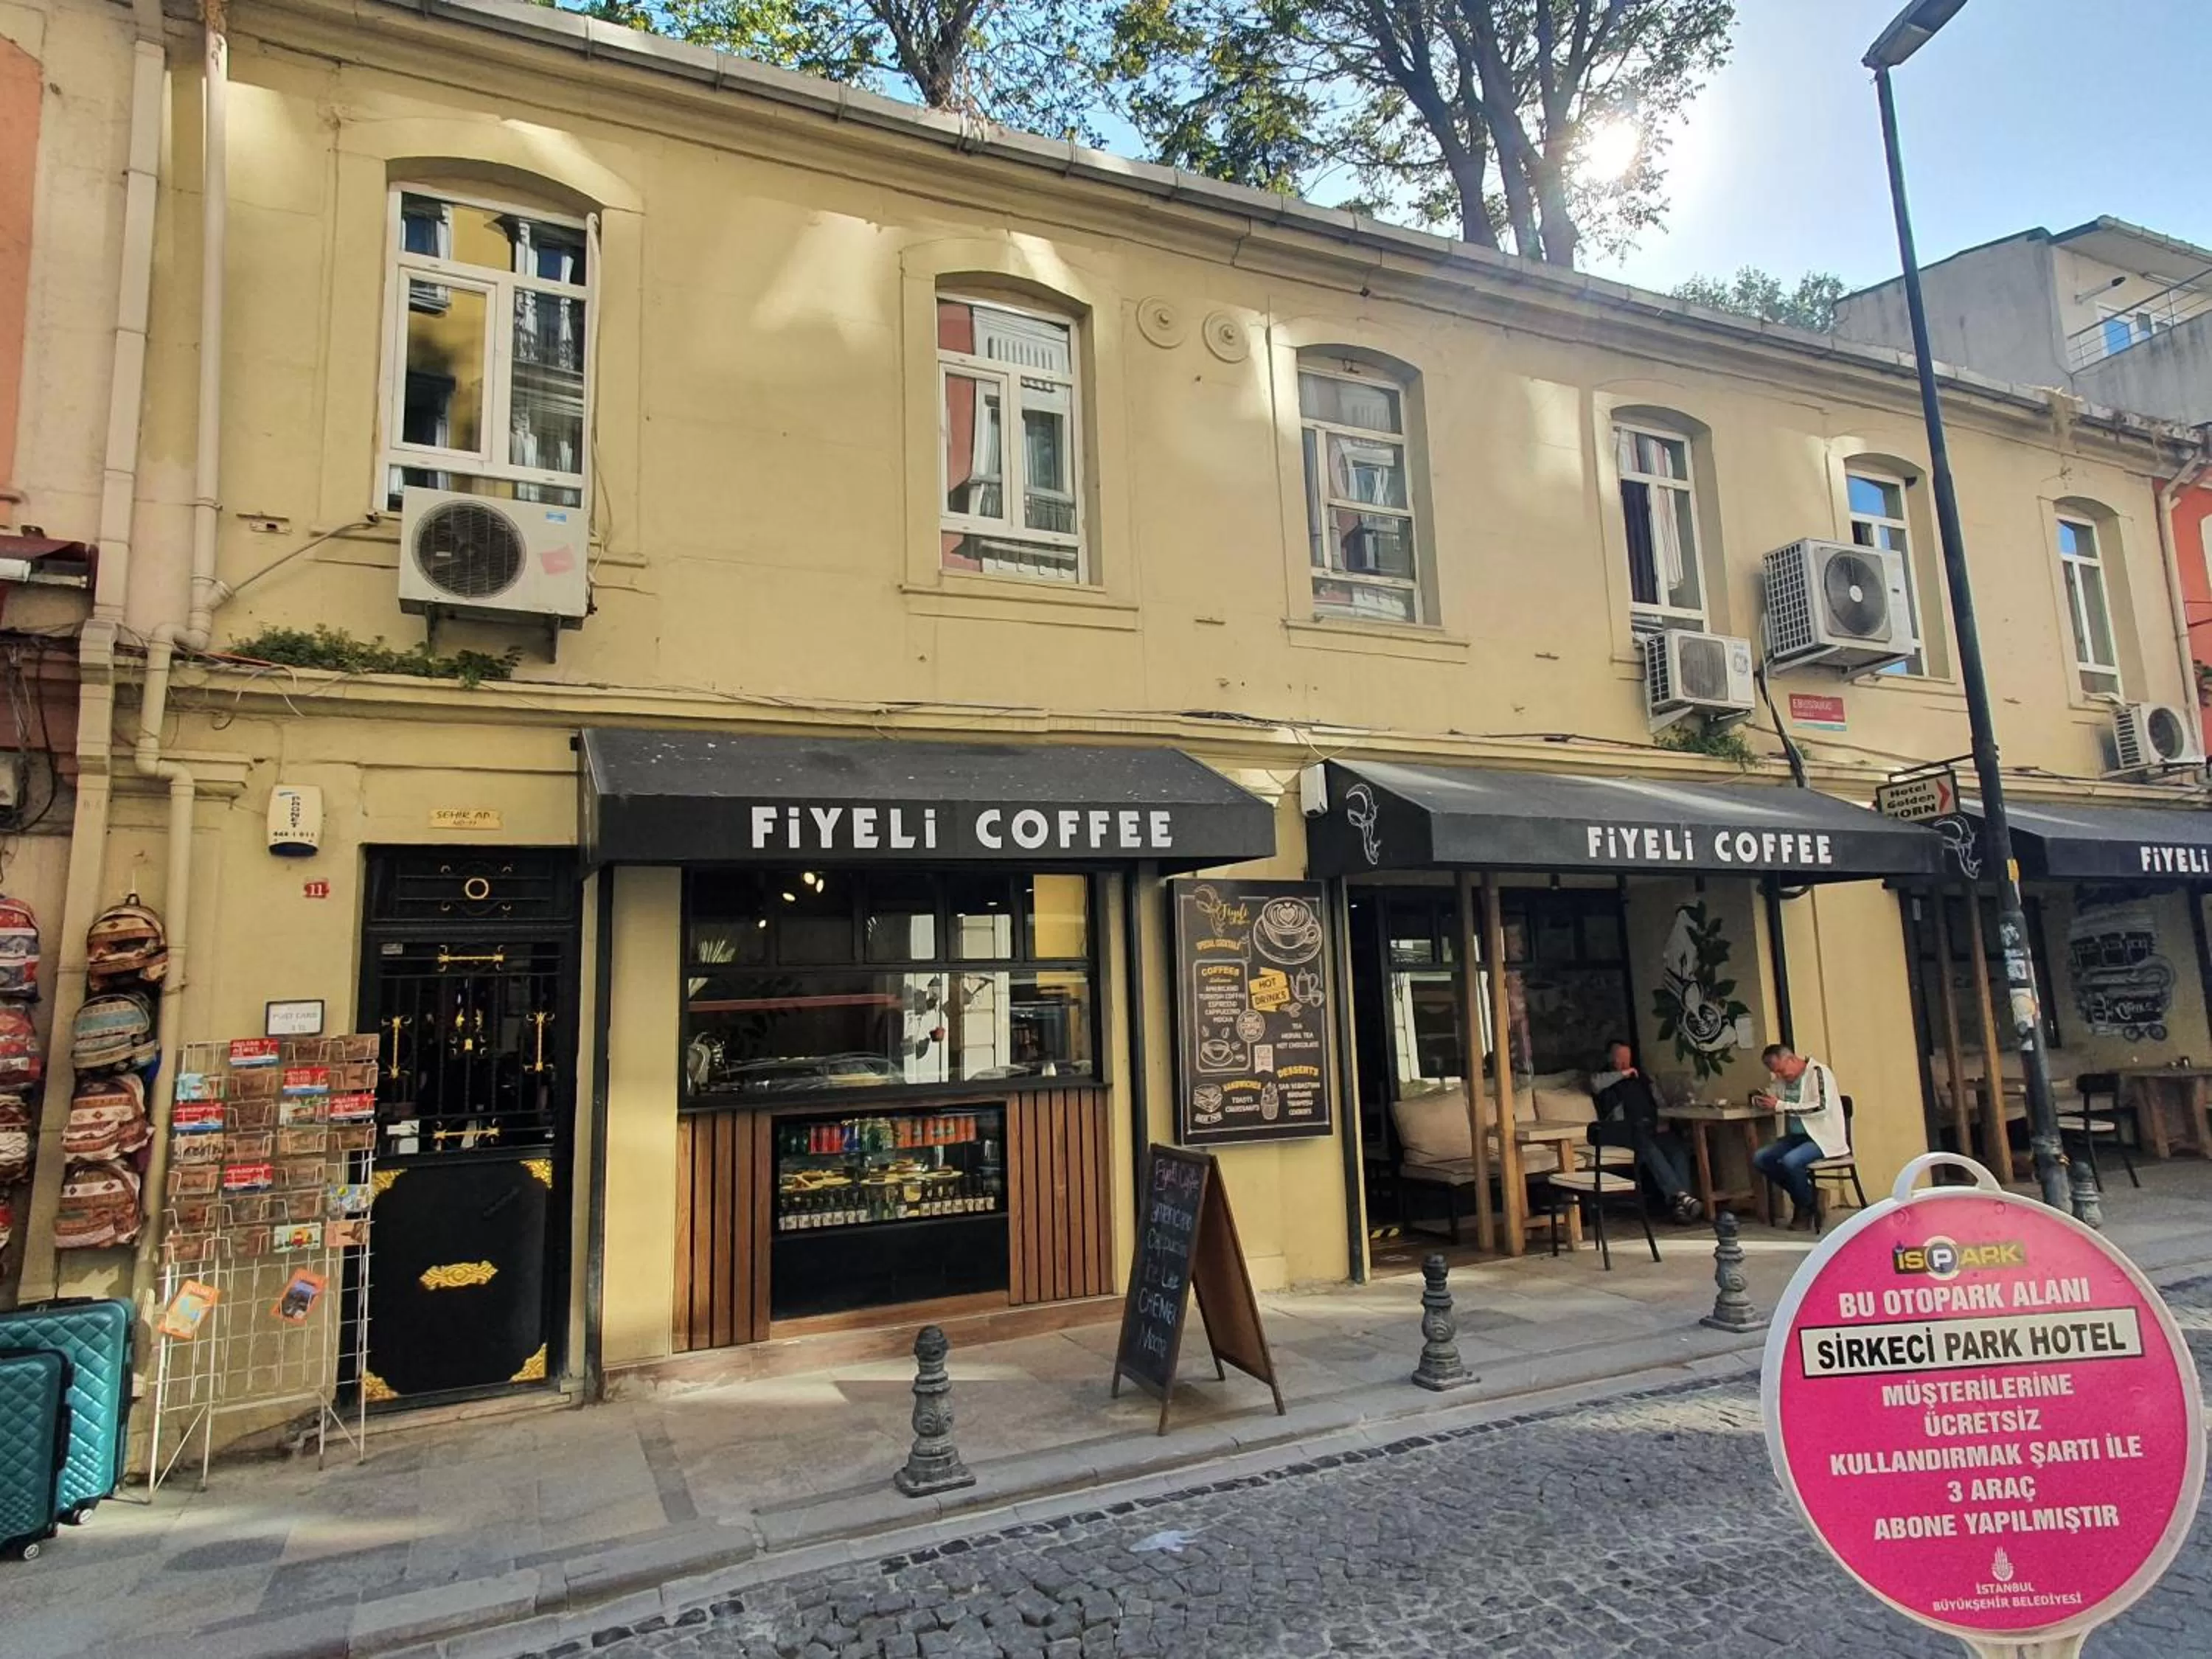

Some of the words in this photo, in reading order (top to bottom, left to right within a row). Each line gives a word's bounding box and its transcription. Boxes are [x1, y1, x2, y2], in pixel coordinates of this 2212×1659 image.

[1888, 794, 1935, 808] Golden
[1891, 783, 1926, 797] Hotel
[975, 808, 1174, 849] COFFEE
[1714, 830, 1832, 865] COFFEE
[1259, 977, 1276, 989] HOT
[1838, 1291, 1874, 1318] BU
[1882, 1282, 2006, 1315] OTOPARK
[2012, 1276, 2091, 1307] ALANI
[1817, 1326, 1935, 1370] SİRKECİ
[1945, 1327, 2023, 1363] PARK
[2031, 1321, 2126, 1355] HOTEL
[1881, 1373, 2075, 1409] MÜŞTERİLERİNE
[1924, 1408, 2042, 1438] ÜCRETSİZ
[1830, 1444, 2022, 1477] KULLANDIRMAK
[2029, 1439, 2101, 1467] ŞARTI
[2105, 1434, 2143, 1460] İLE
[1947, 1480, 1964, 1503] 3
[1971, 1475, 2037, 1503] ARAÇ
[1874, 1516, 1958, 1542] ABONE
[1964, 1504, 2121, 1536] YAPILMIŞTIR
[1932, 1595, 2010, 1612] BÜYÜKŞEHİR
[2012, 1590, 2082, 1607] BELEDİYESİ
[1975, 1581, 2035, 1595] İSTANBUL
